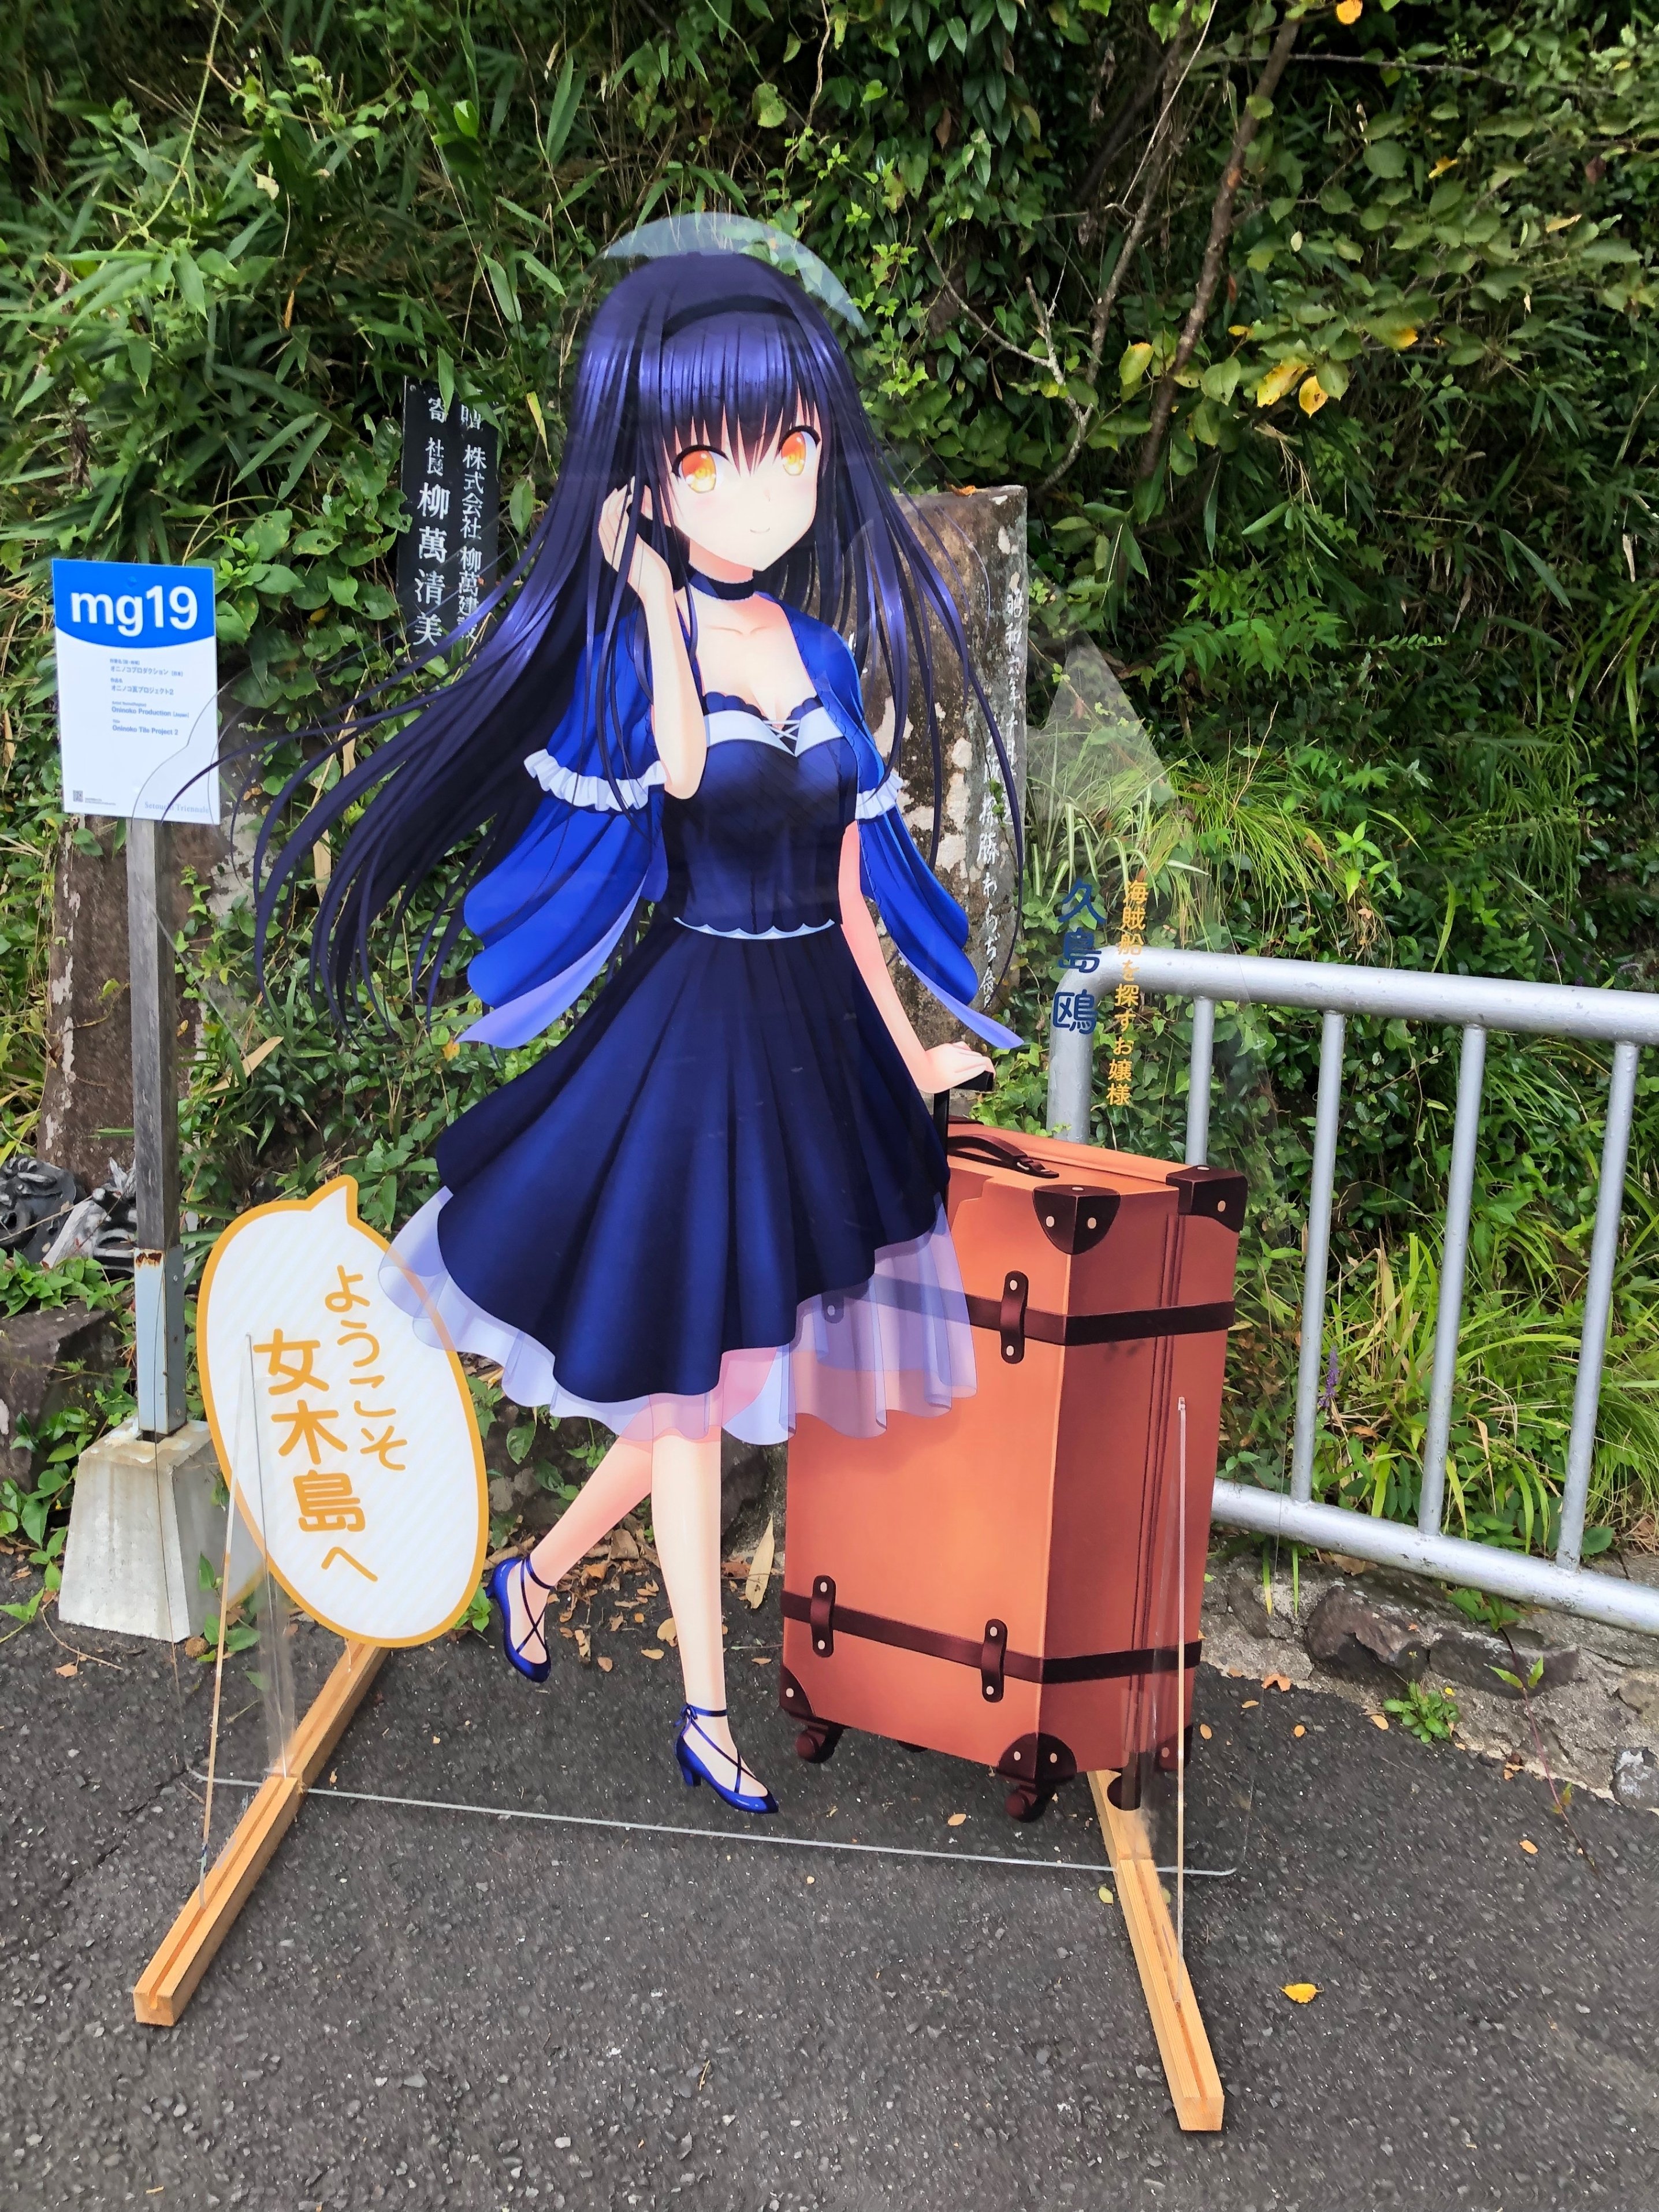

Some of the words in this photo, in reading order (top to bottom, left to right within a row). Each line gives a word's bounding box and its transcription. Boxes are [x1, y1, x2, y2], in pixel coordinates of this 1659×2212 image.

[70, 585, 198, 638] mg19
[111, 706, 137, 714] Oninoko
[138, 708, 172, 717] Production
[112, 724, 137, 733] Oninoko
[151, 727, 173, 736] Project
[1106, 879, 1148, 1107] 海賊船を探すお嬢様
[324, 1264, 407, 1471] ようこそ
[253, 1328, 378, 1582] 女木島へ
